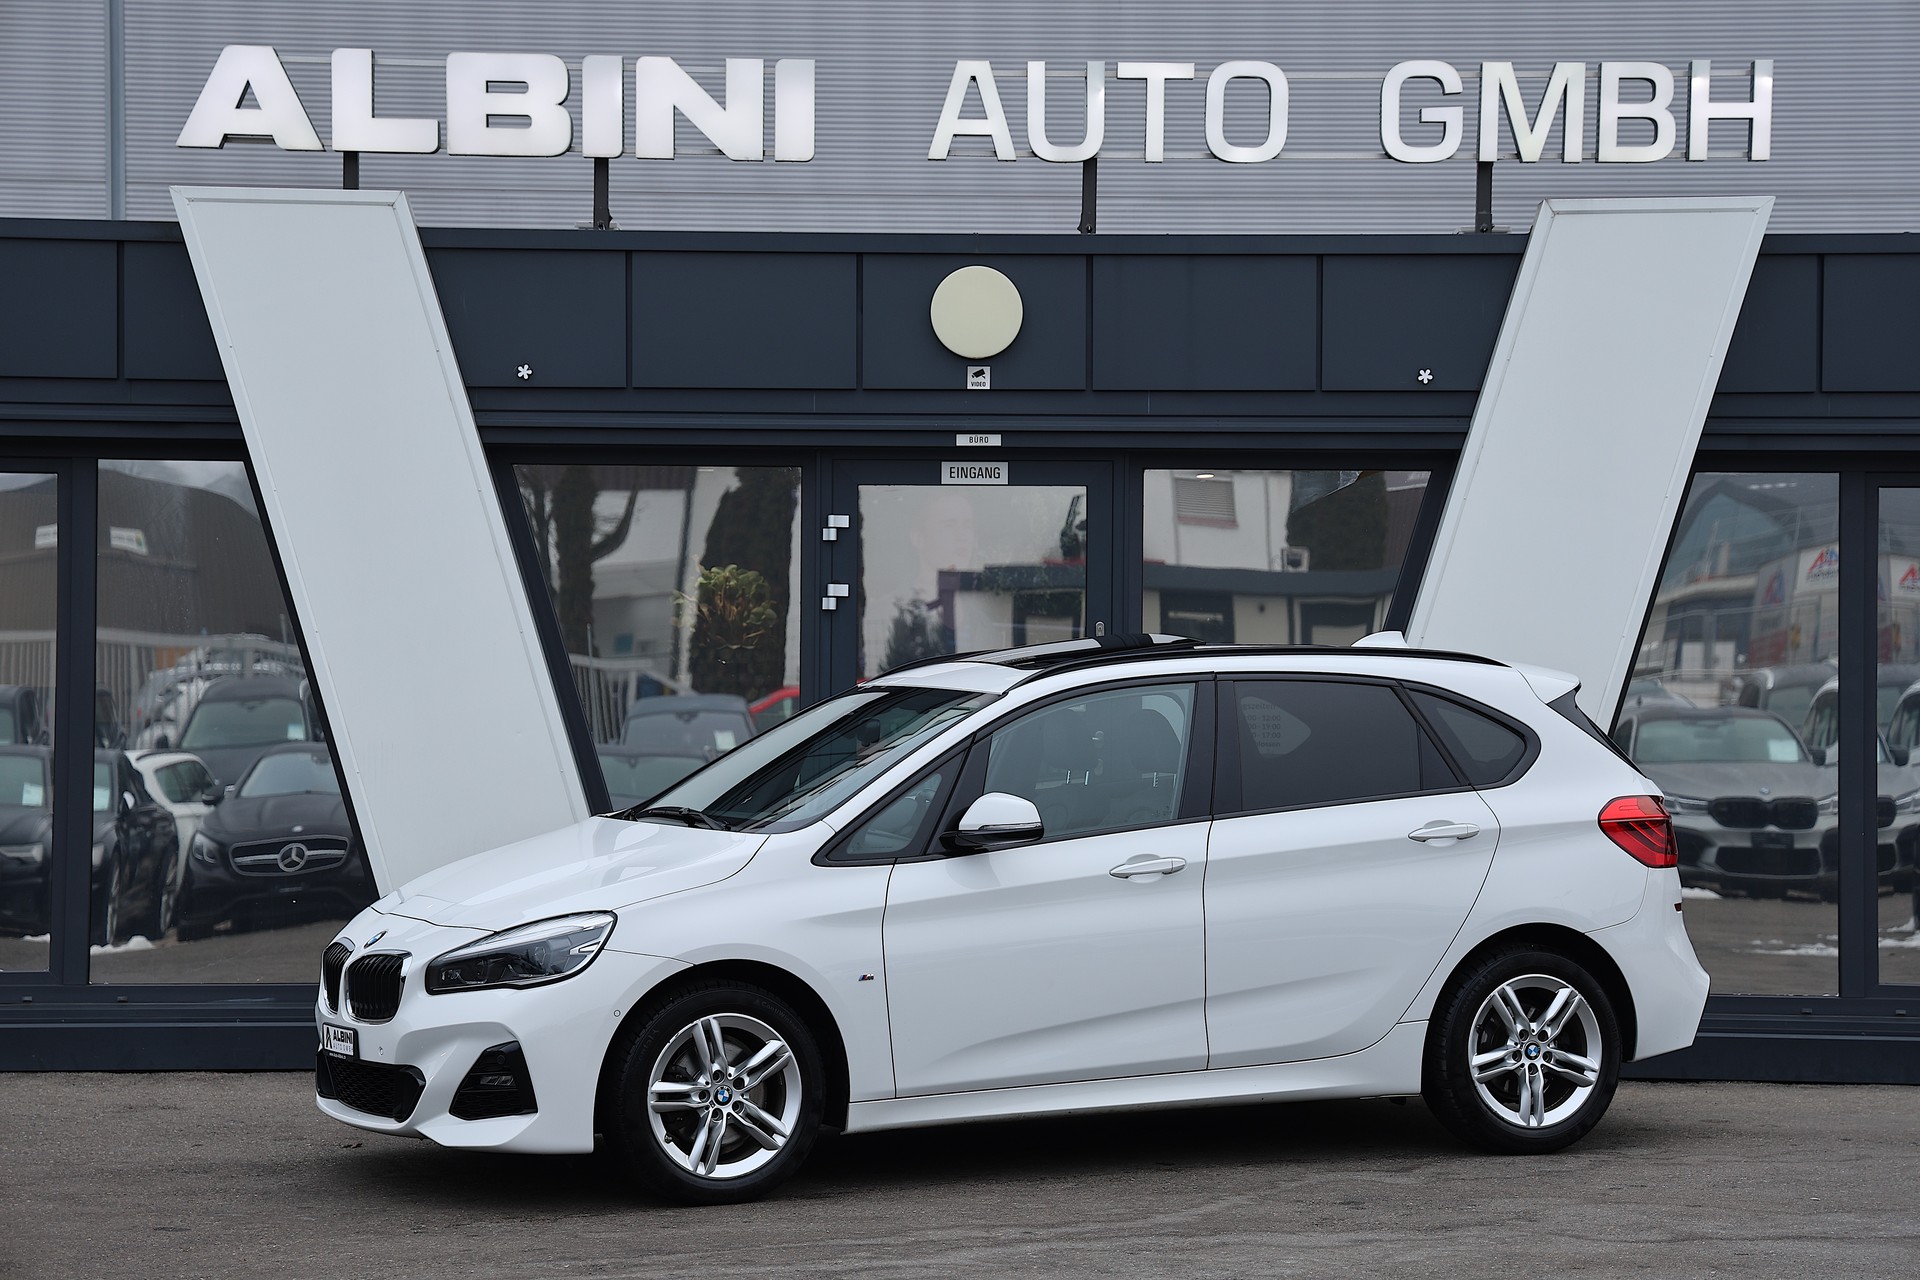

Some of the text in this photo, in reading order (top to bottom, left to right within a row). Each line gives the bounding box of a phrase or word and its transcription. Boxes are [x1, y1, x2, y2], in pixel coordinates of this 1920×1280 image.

[175, 44, 1774, 163] ALBINI AUTO GMBH
[969, 435, 989, 444] BÜRO
[949, 466, 1001, 479] EINGANG
[333, 1029, 353, 1045] ALBINI
